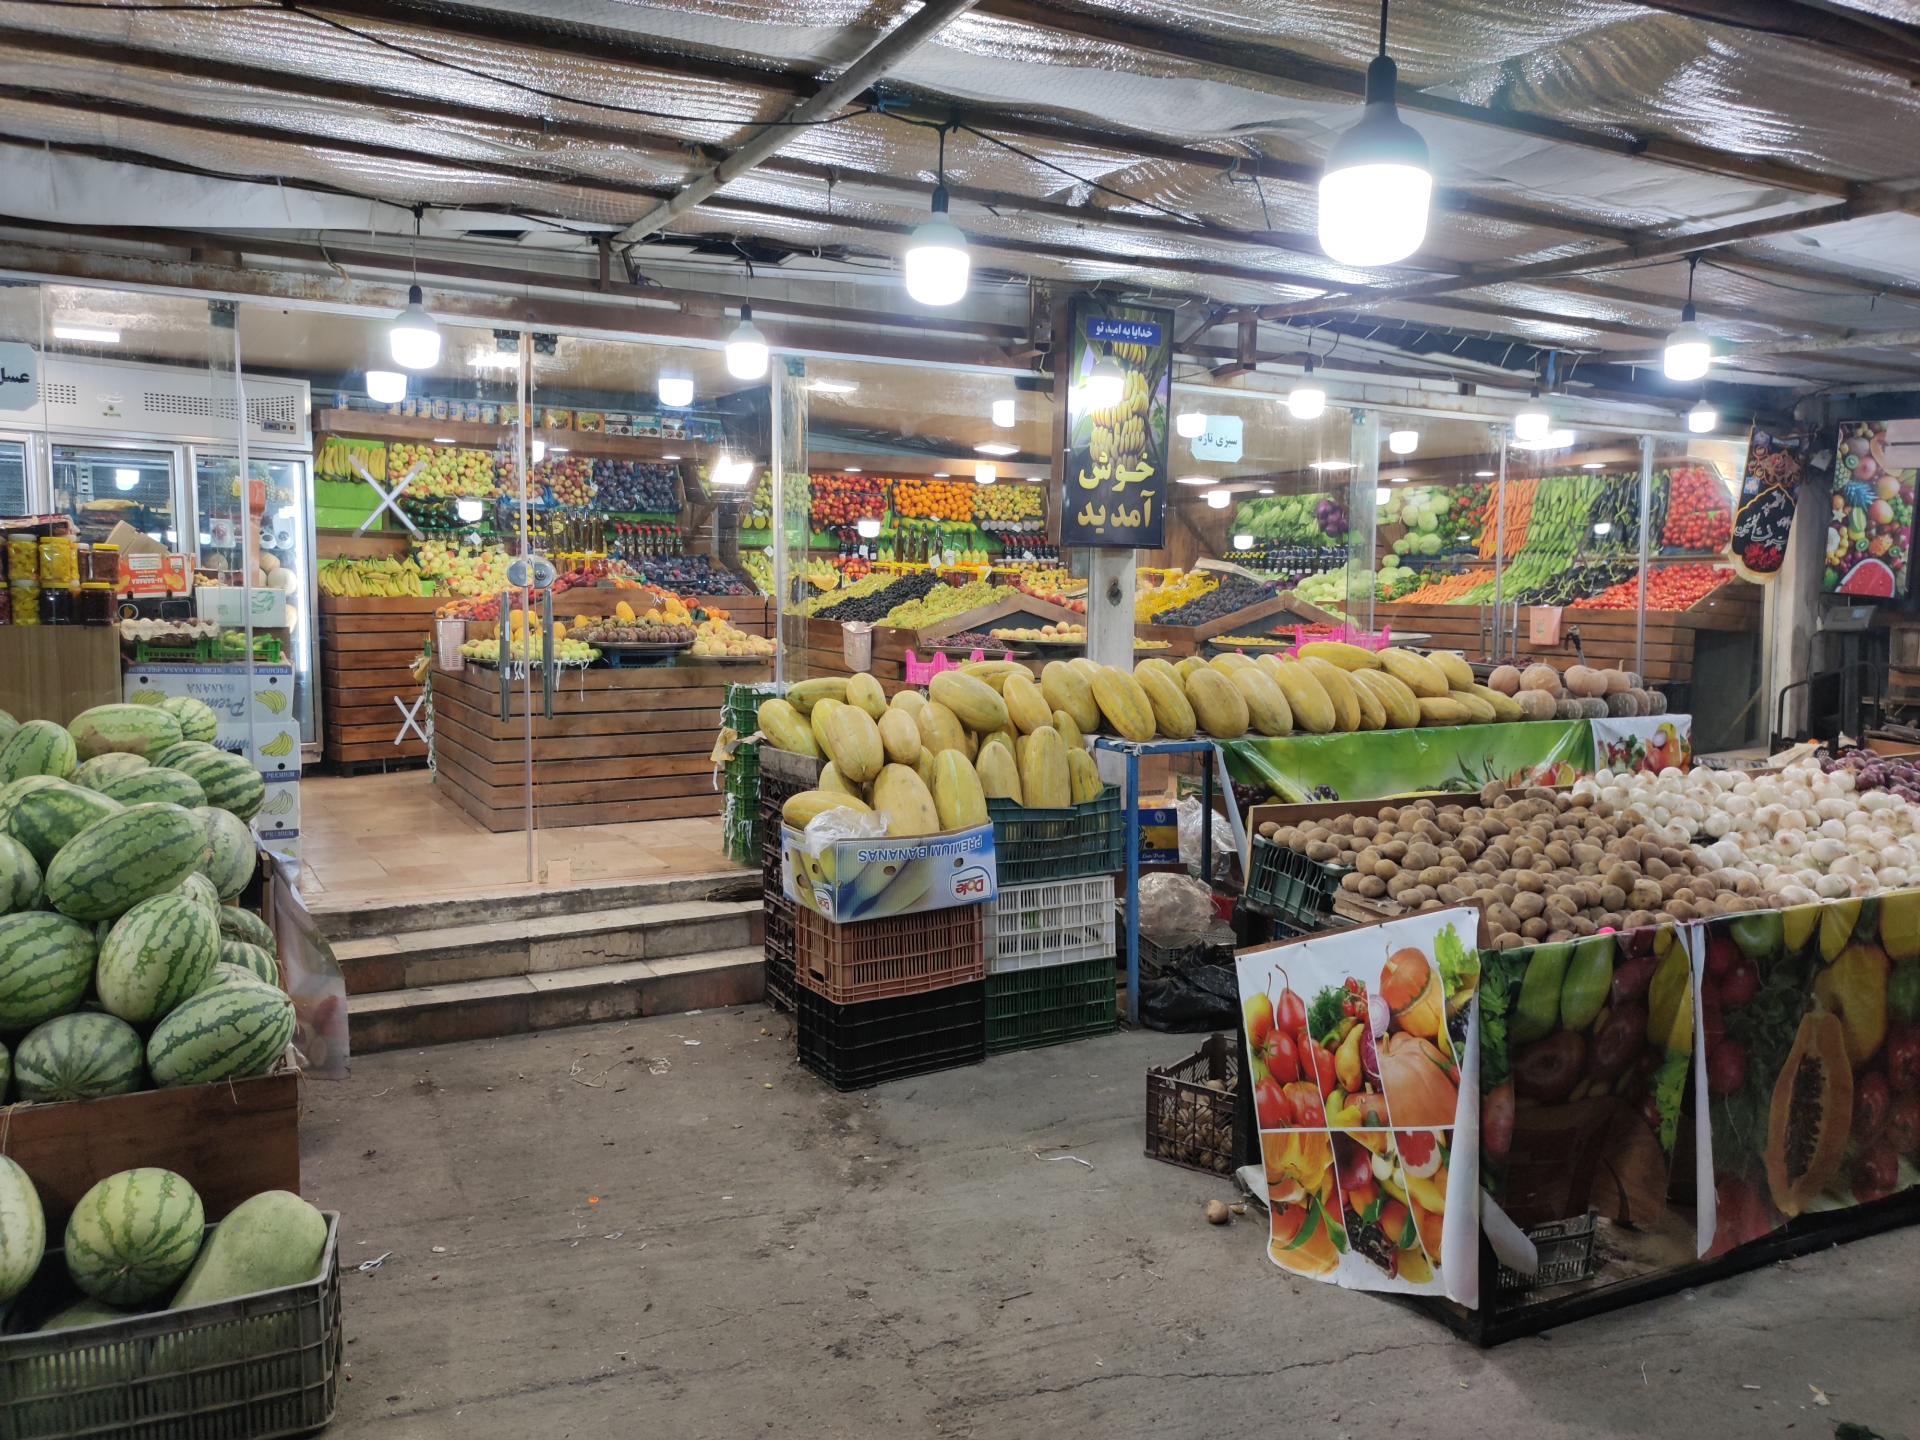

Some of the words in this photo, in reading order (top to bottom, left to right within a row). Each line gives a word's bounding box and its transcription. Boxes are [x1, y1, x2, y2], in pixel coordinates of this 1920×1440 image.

[1095, 322, 1104, 335] تو
[1105, 324, 1122, 337] امید
[1121, 327, 1131, 339] به
[1131, 326, 1153, 339] خدایا
[1215, 435, 1238, 448] سبزی
[1078, 451, 1155, 491] خوش
[1077, 490, 1156, 533] آمدید
[266, 771, 295, 779] PREMIUM
[931, 834, 983, 857] PREMIUM
[858, 844, 927, 863] BANANAS
[955, 878, 984, 894] Dole
